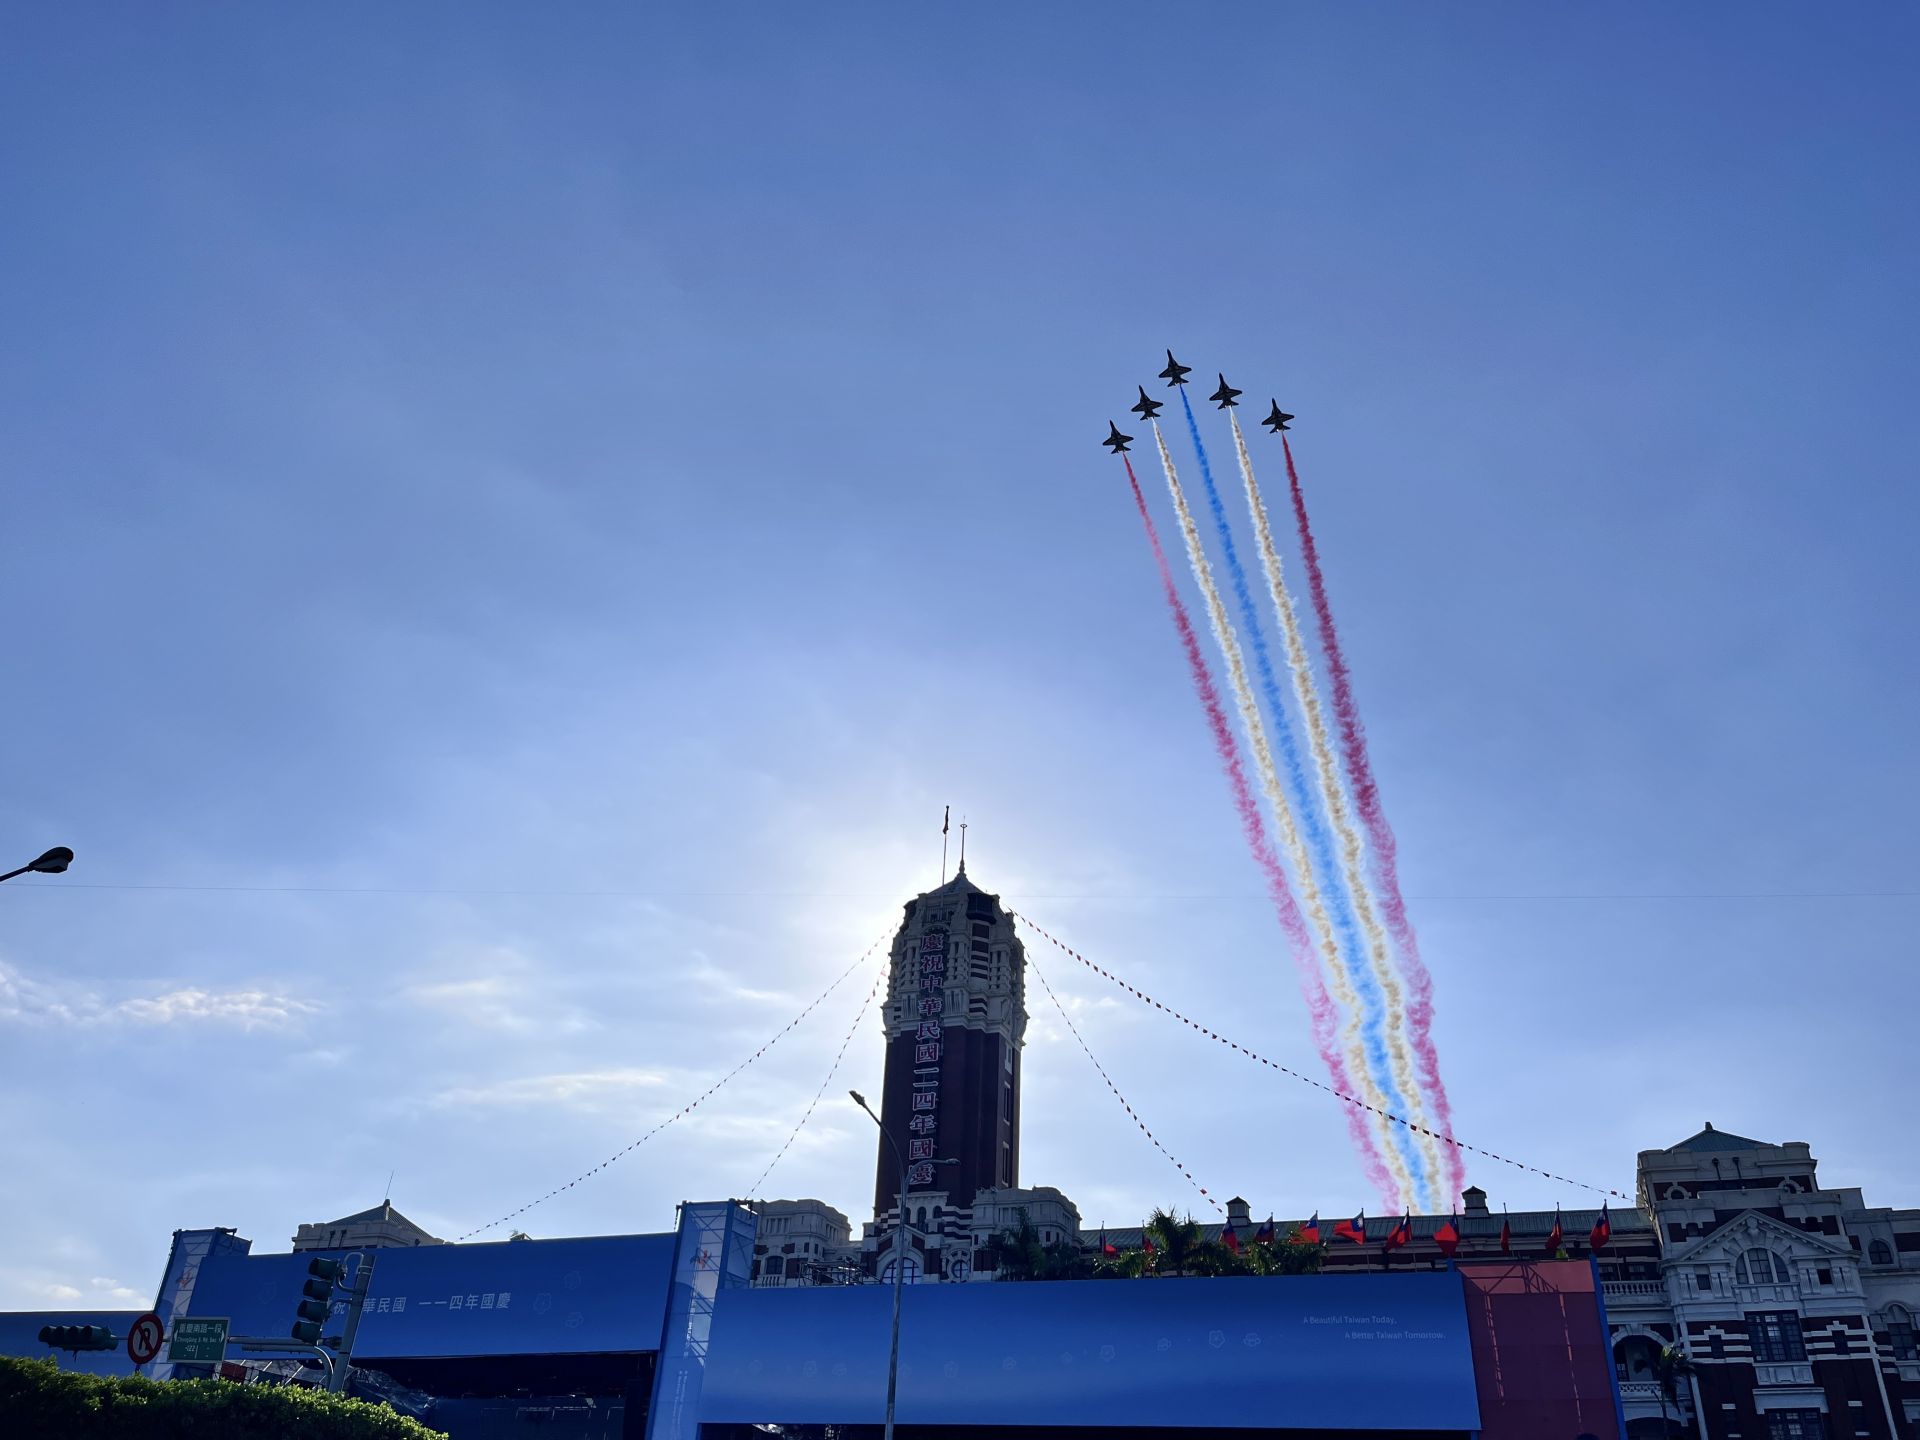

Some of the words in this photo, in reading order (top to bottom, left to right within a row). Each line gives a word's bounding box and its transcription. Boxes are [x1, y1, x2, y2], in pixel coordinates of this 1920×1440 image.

[333, 1297, 407, 1314] 祝華民國
[419, 1292, 512, 1311] 一一四年國慶
[1303, 1316, 1308, 1324] A
[1309, 1316, 1342, 1324] Beautiful
[1344, 1316, 1370, 1324] Taiwan
[1376, 1331, 1402, 1339] Taiwan
